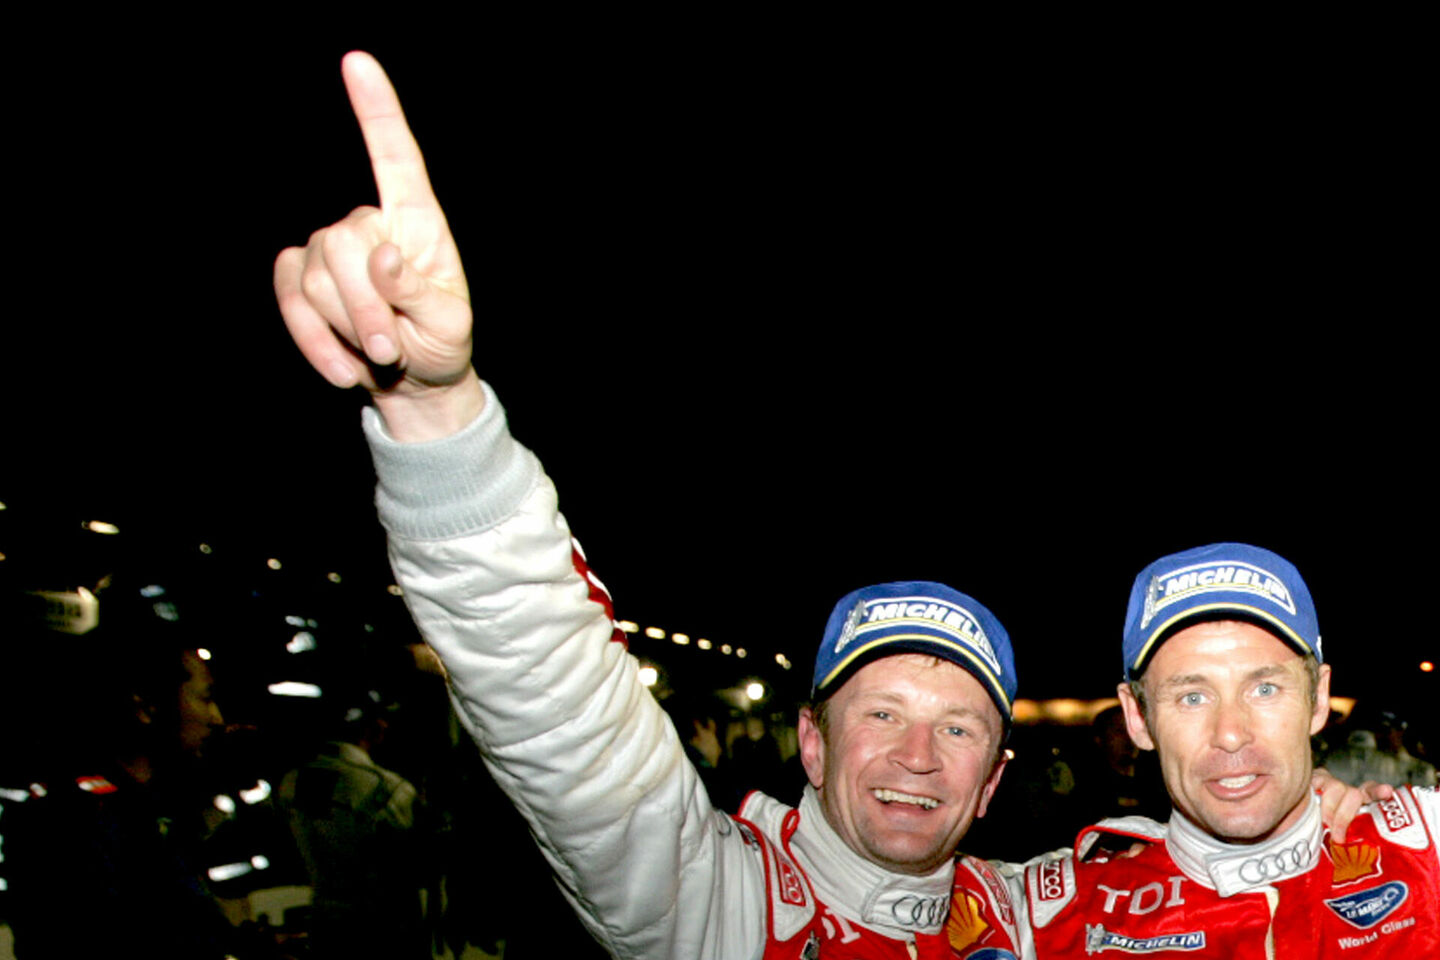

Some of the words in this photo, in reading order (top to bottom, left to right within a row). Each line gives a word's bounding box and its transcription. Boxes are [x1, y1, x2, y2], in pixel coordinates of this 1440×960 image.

[1165, 567, 1287, 600] MICHELIN
[1097, 875, 1188, 915] TDI
[1111, 934, 1200, 950] MICHELIN
[1338, 931, 1378, 950] World
